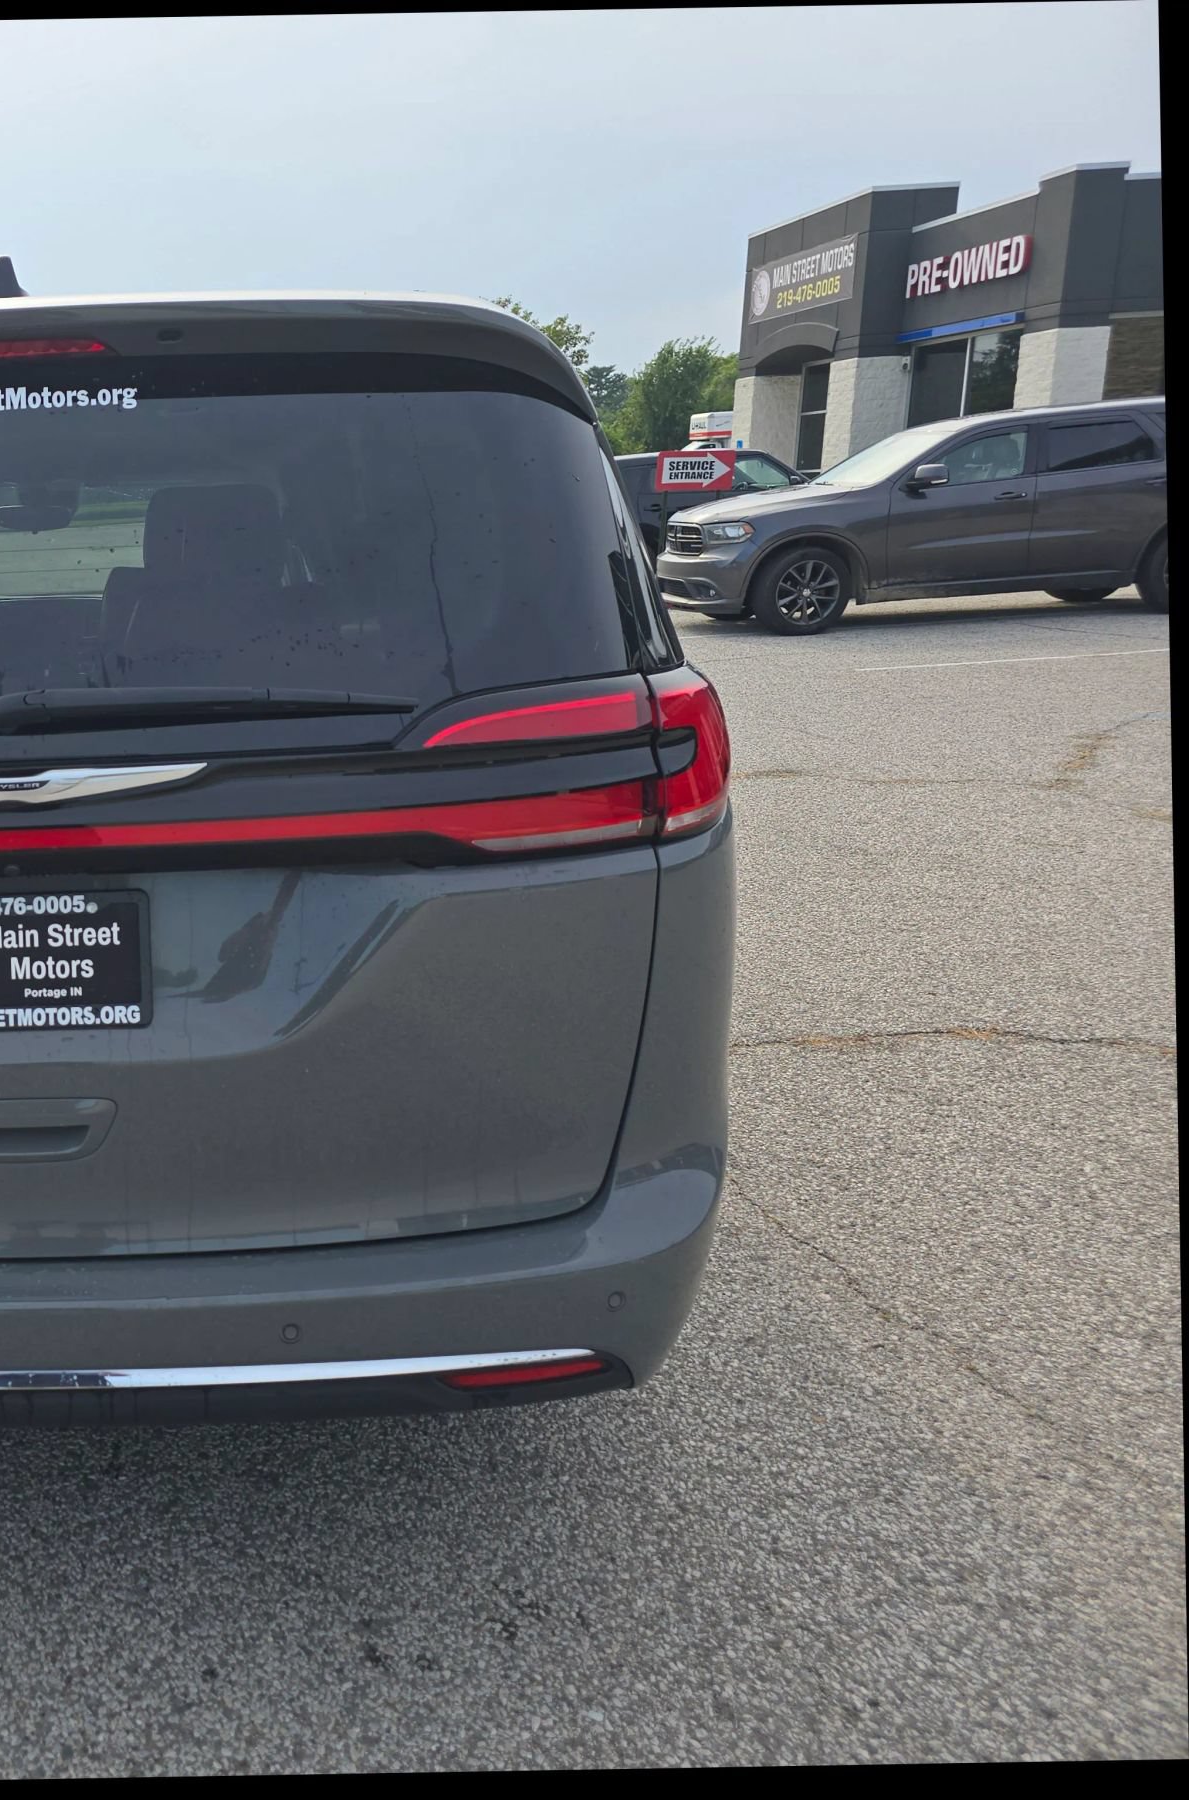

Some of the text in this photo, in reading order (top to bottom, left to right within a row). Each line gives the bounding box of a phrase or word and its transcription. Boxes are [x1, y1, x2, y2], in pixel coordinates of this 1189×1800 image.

[772, 243, 855, 289] MAIN STREET MOTORS
[905, 234, 1027, 299] PRE-OWNED
[776, 275, 841, 309] 219-476-0005
[668, 460, 716, 471] SERVICE
[669, 471, 715, 480] ENTRANCE
[47, 922, 120, 947] Street
[10, 956, 94, 980] Motors
[24, 987, 82, 998] Portage IN
